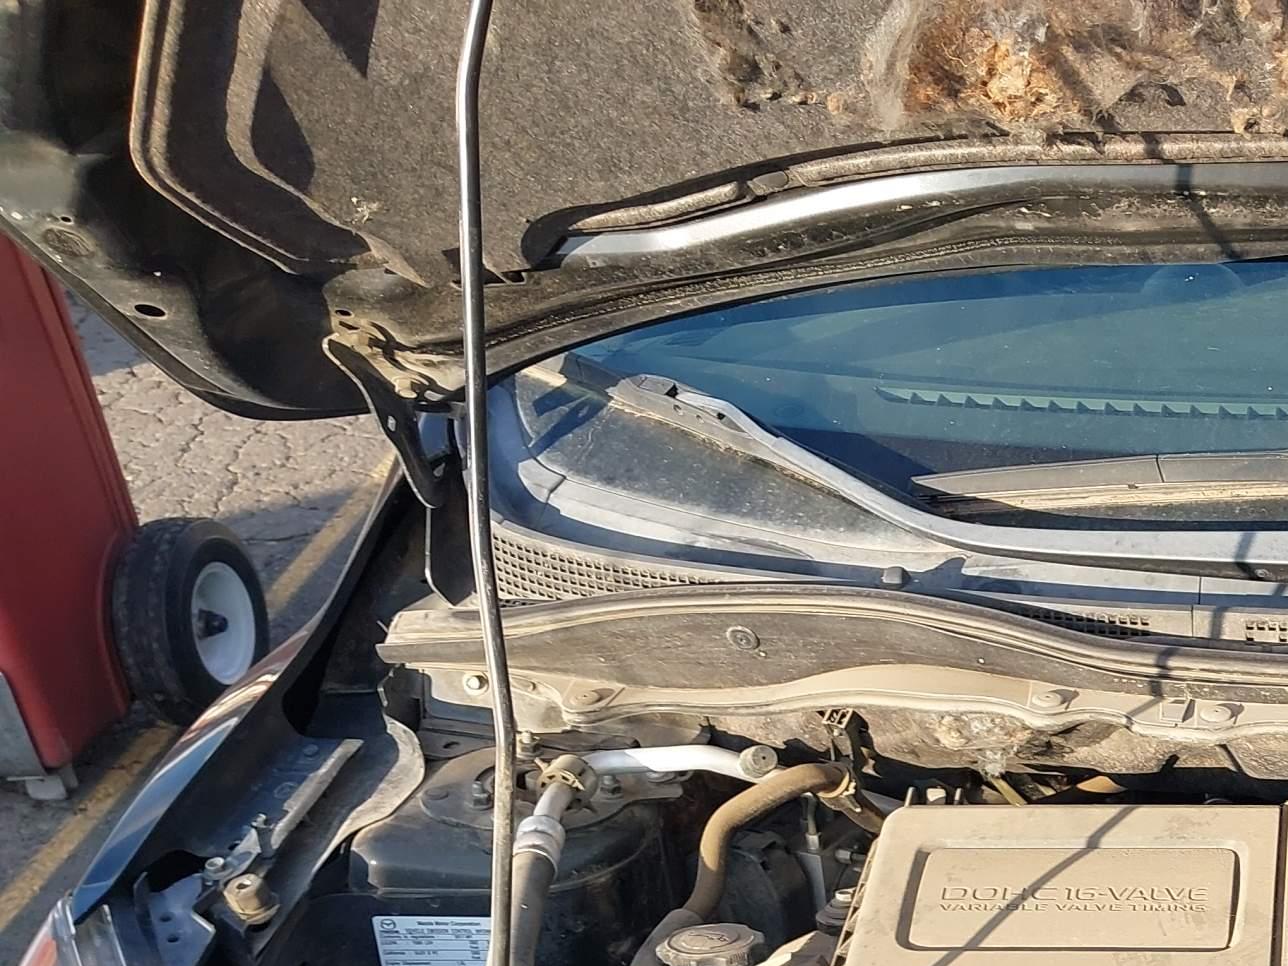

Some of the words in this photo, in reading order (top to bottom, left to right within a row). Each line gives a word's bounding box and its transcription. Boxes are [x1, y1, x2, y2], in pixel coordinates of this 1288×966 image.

[941, 886, 1057, 901] DOHC
[1065, 886, 1209, 902] 16-VALVE
[939, 902, 1049, 913] VARIABLE
[1055, 902, 1123, 913] VALVE
[1127, 902, 1207, 914] TIMING
